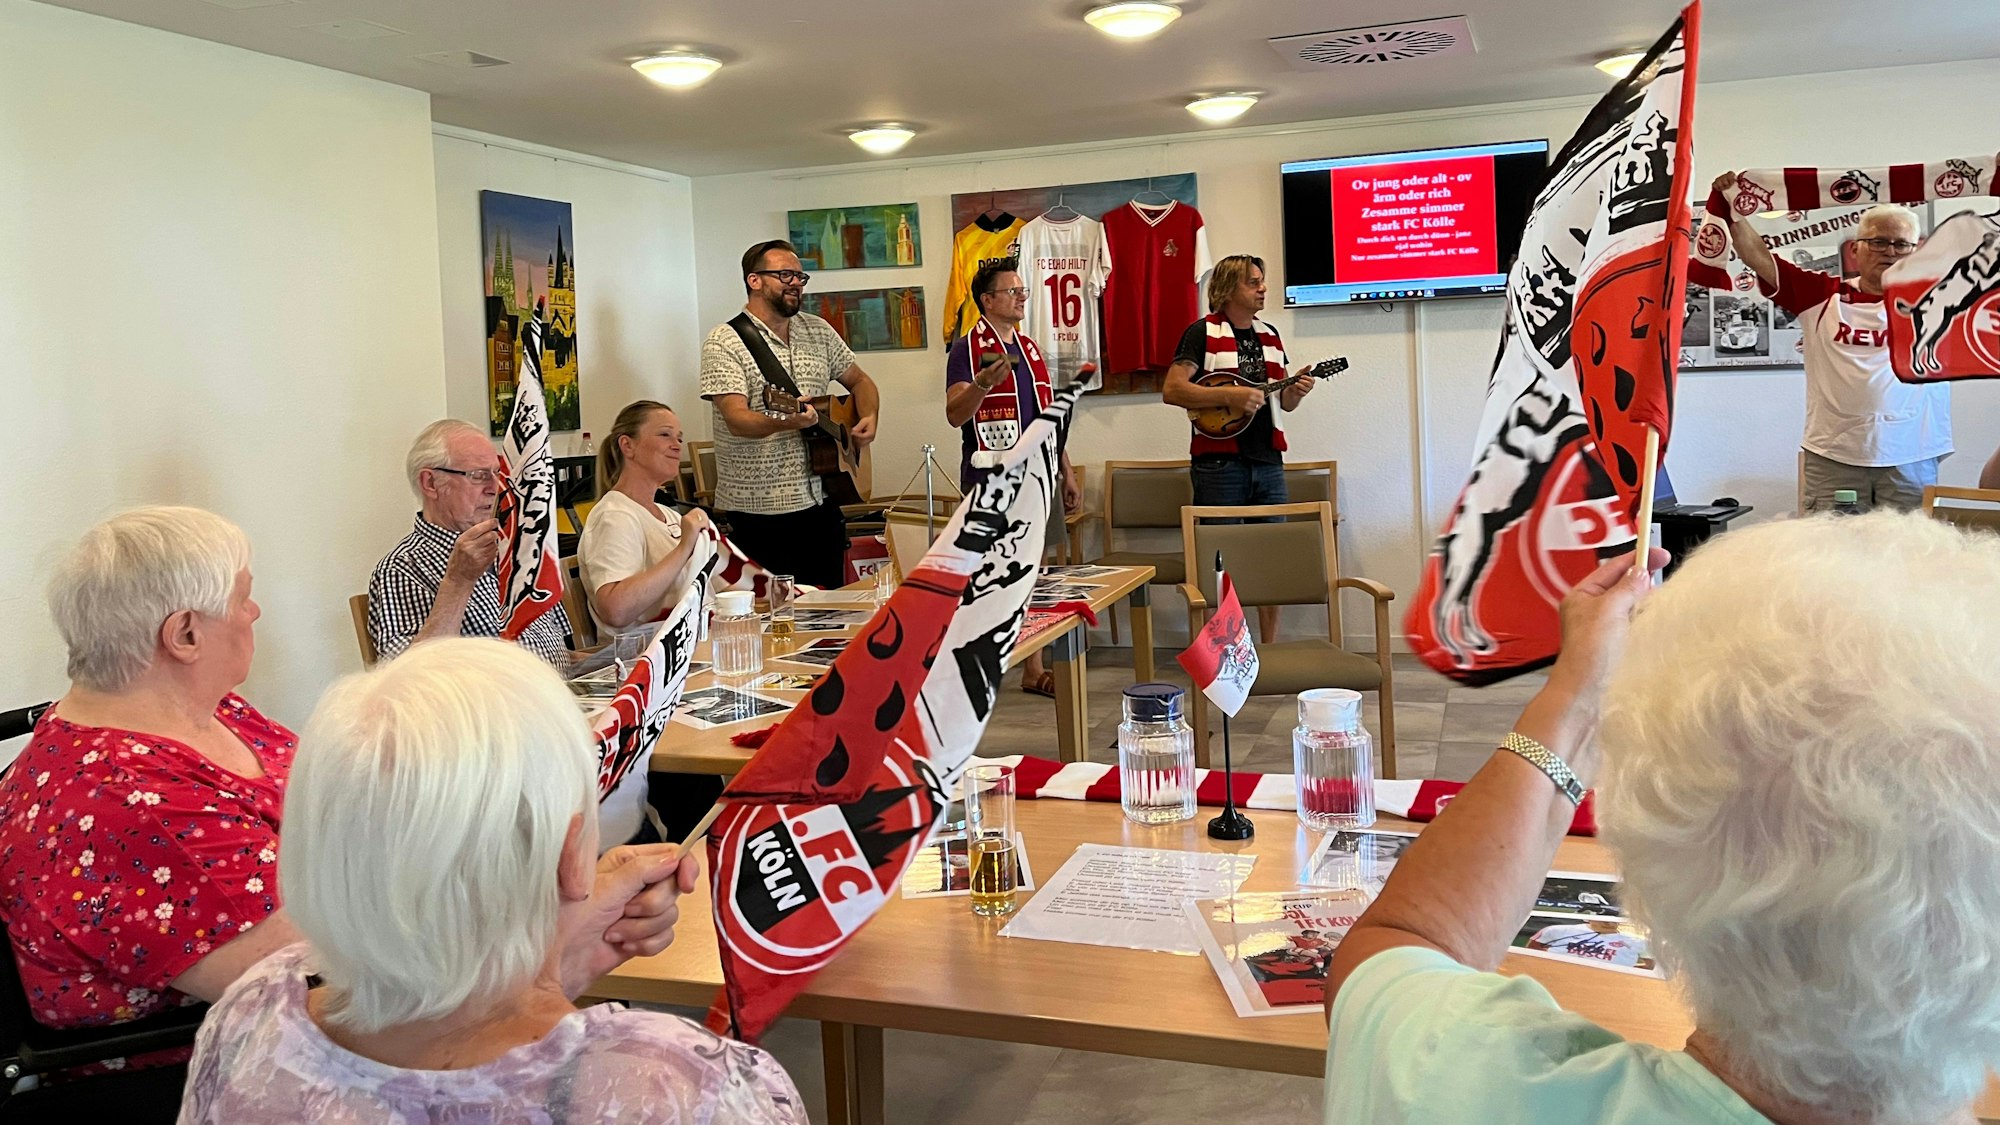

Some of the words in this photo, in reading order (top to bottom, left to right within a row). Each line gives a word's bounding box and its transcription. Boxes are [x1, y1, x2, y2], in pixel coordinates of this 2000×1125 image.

[1352, 180, 1369, 190] Ov
[1372, 179, 1400, 191] jung
[1402, 176, 1429, 187] oder
[1431, 173, 1447, 184] alt
[1457, 174, 1472, 182] ov
[1398, 190, 1426, 201] oder
[1428, 187, 1452, 199] rich
[1361, 207, 1418, 218] Zesamme
[1420, 203, 1465, 214] simmer
[1371, 221, 1400, 232] stark
[1404, 219, 1420, 230] FC
[1423, 216, 1455, 228] Kölle
[1044, 273, 1082, 328] 16
[1833, 321, 1888, 347] REW
[747, 830, 807, 912] KÖLN
